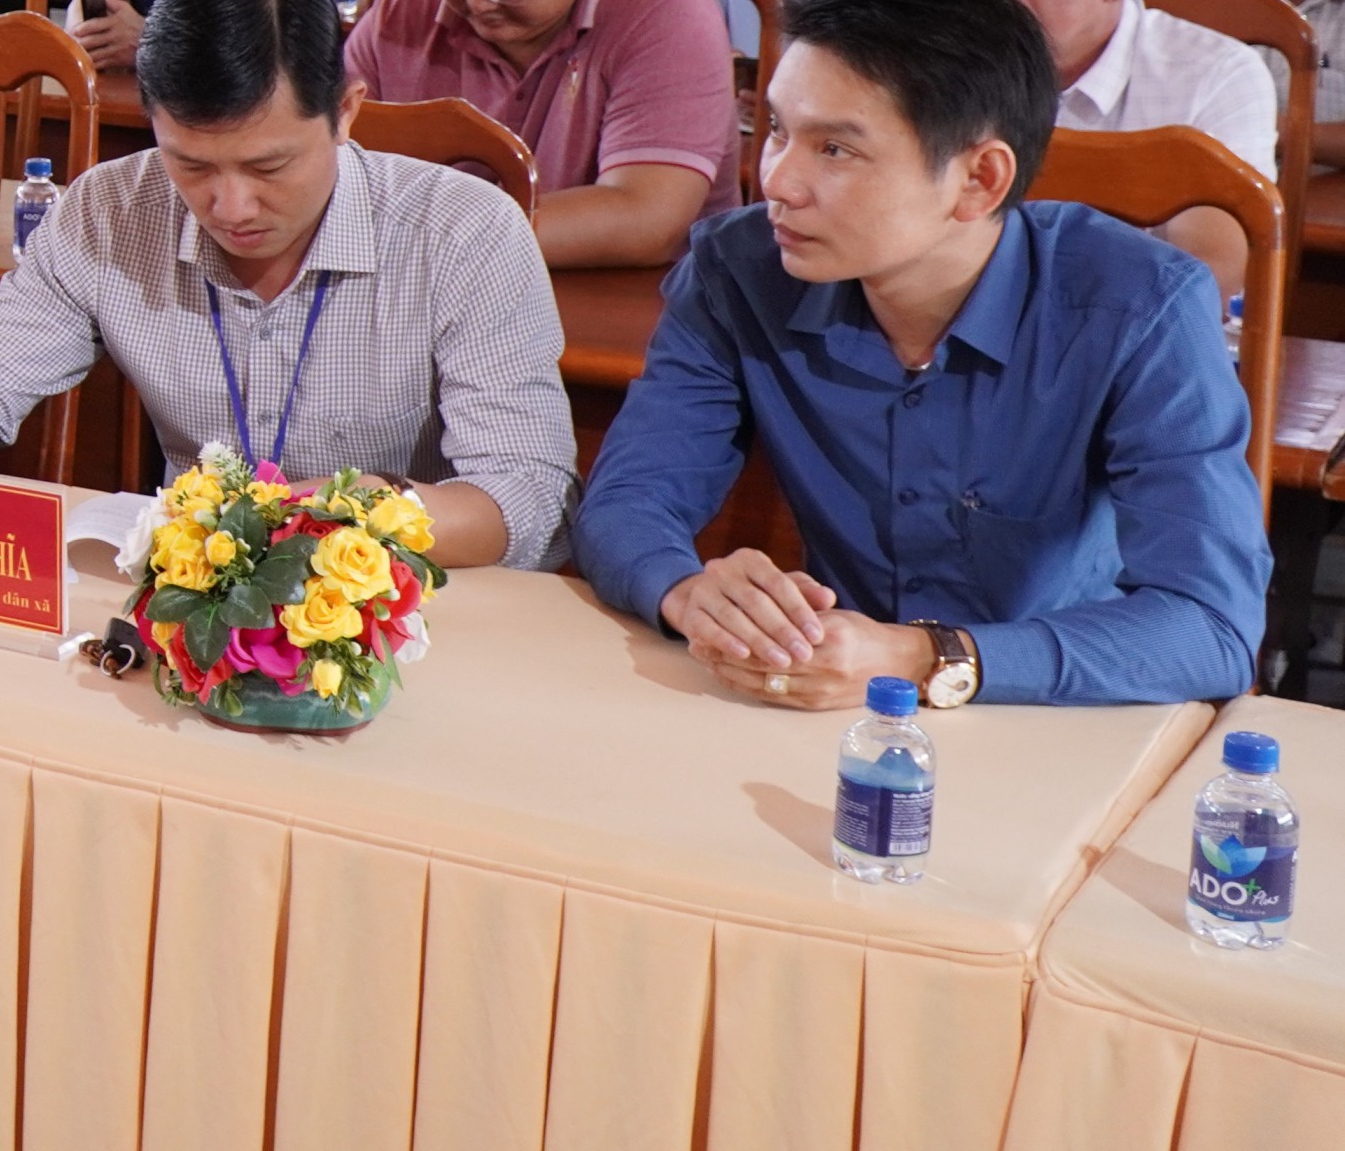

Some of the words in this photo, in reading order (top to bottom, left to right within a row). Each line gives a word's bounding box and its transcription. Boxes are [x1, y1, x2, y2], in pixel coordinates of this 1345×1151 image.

[2, 591, 29, 609] dân
[34, 598, 51, 613] xã
[1189, 867, 1248, 906] ADO
